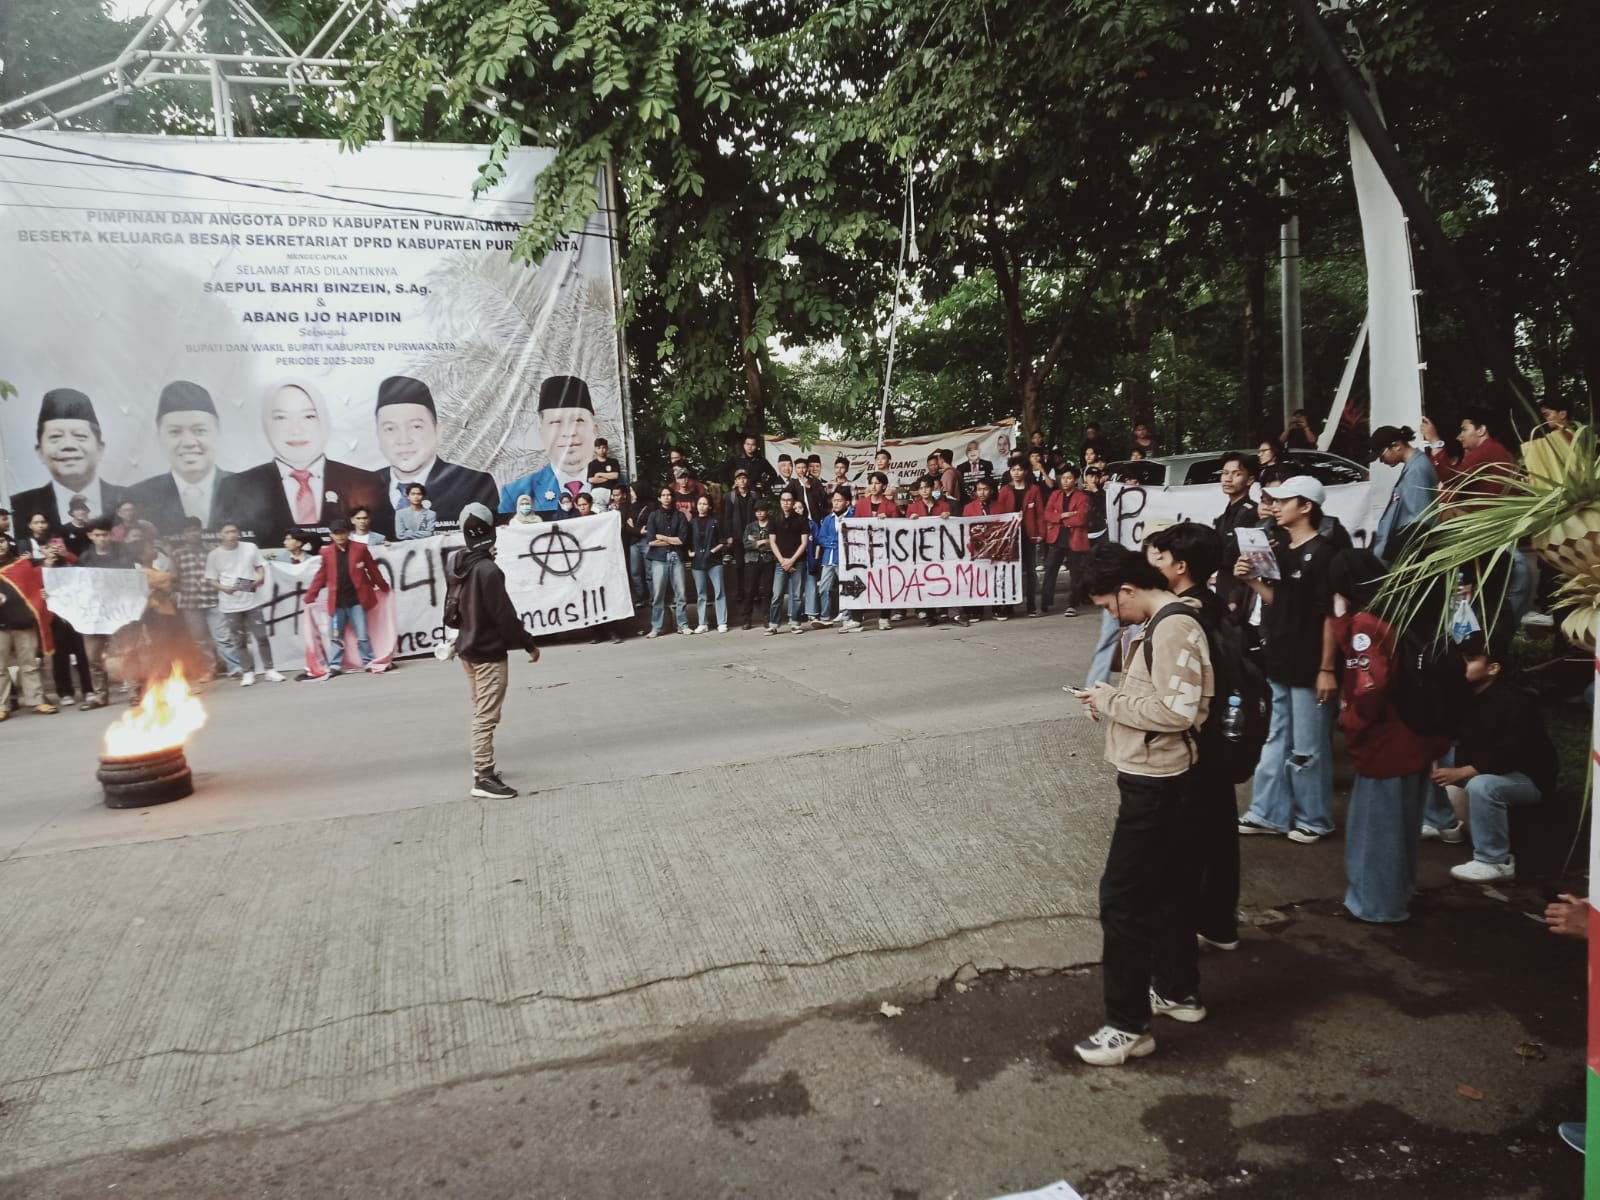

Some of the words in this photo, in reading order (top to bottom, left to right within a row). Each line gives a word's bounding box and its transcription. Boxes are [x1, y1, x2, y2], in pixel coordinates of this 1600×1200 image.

[87, 210, 166, 224] PIMPINAN
[171, 211, 204, 225] DAN
[208, 213, 283, 227] ANGGOTA
[288, 215, 328, 227] DPRD
[333, 216, 419, 230] KABUPATEN
[425, 217, 520, 232] PURWAKARTA
[18, 229, 92, 243] BESERTA
[98, 231, 184, 245] KELUARGA
[190, 232, 241, 246] BESAR
[246, 233, 348, 248] SEKRETARIAT
[354, 236, 392, 249] DPRD
[397, 237, 482, 251] KABUPATEN
[486, 239, 579, 252] PURRTA
[236, 265, 290, 275] SELAMAT
[294, 265, 321, 275] ATAS
[324, 266, 398, 276] DILANTIKNYA
[203, 282, 266, 293] SAEPUL
[270, 282, 319, 293] BAHRI
[324, 282, 391, 294] BINZEIN,
[394, 283, 432, 296] S.Ag.
[315, 297, 326, 308] &
[242, 311, 300, 323] ABANG
[304, 311, 331, 323] IJO
[336, 311, 402, 323] HAPIDIN
[298, 327, 346, 339] Sebagai
[186, 343, 223, 352] BUPATI
[225, 343, 249, 352] DAN
[251, 343, 285, 352] WAKIL
[287, 343, 324, 352] BUPATI
[326, 343, 385, 352] KABUPATEN
[388, 342, 456, 352] PURWAKARTA
[275, 356, 321, 366] PERIODE
[323, 356, 375, 366] 2025-2030
